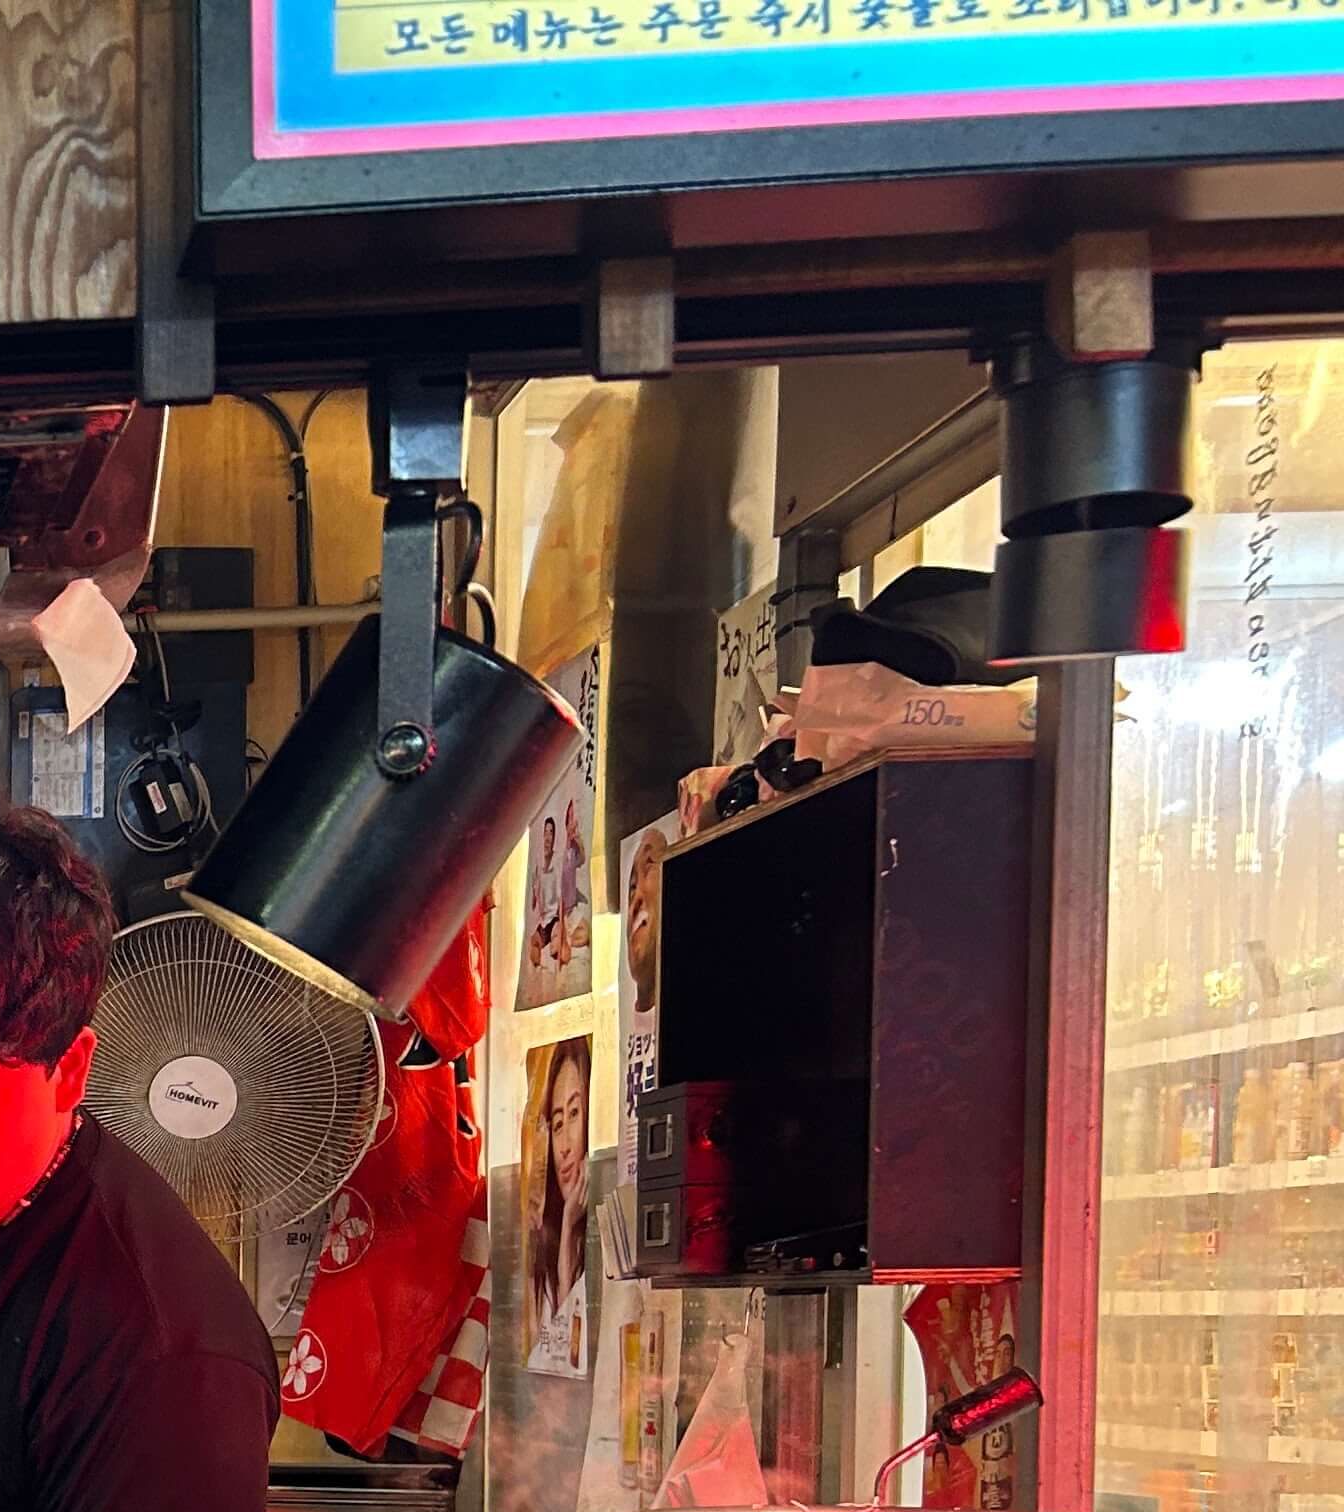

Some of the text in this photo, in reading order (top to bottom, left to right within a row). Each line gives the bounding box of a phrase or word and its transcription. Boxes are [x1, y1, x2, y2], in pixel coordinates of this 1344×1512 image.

[385, 11, 475, 55] 모든
[491, 7, 625, 52] 메뉴는
[640, 0, 732, 42] 주문
[901, 699, 946, 726] 150
[169, 1088, 220, 1110] HOMEVIT
[287, 1232, 311, 1246] 문어
